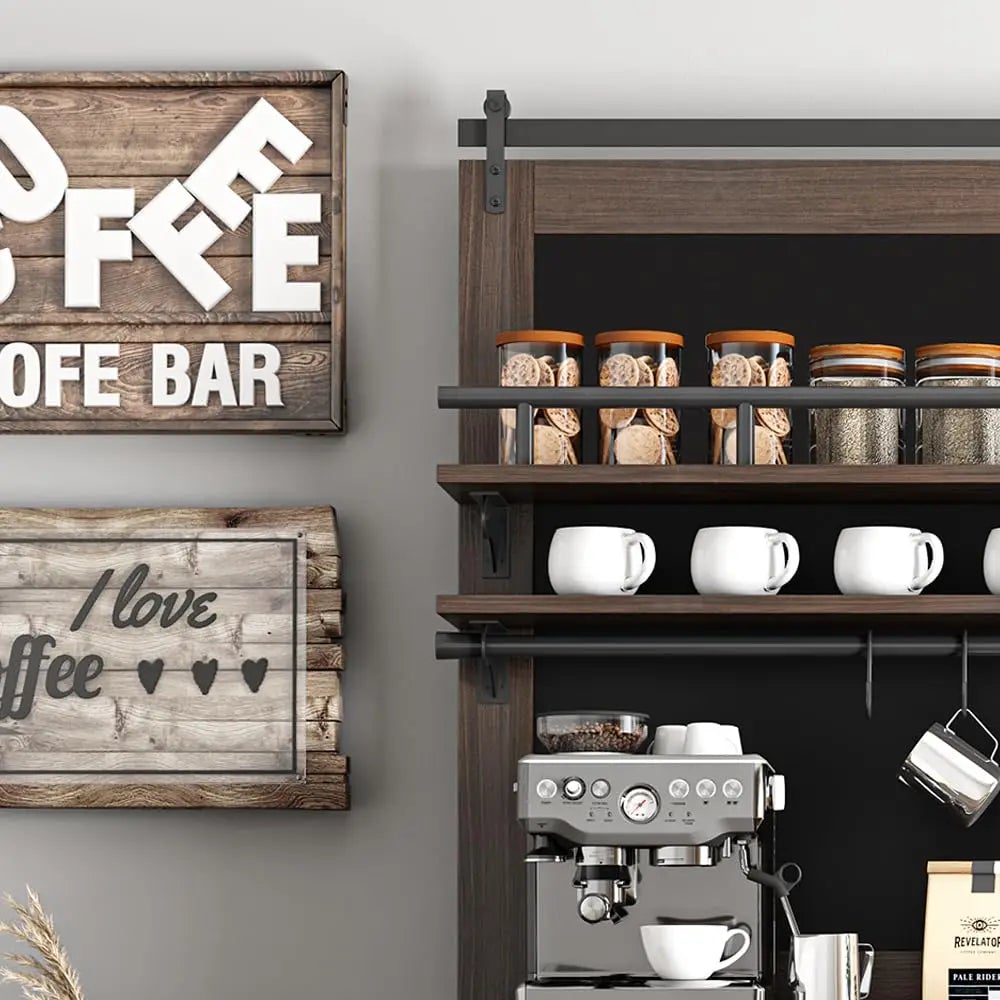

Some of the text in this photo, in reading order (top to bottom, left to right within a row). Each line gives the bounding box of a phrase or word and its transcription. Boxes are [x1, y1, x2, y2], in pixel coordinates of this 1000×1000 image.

[152, 342, 285, 407] BAR
[111, 563, 218, 629] love
[0, 634, 104, 720] ffee
[952, 973, 974, 981] PALE
